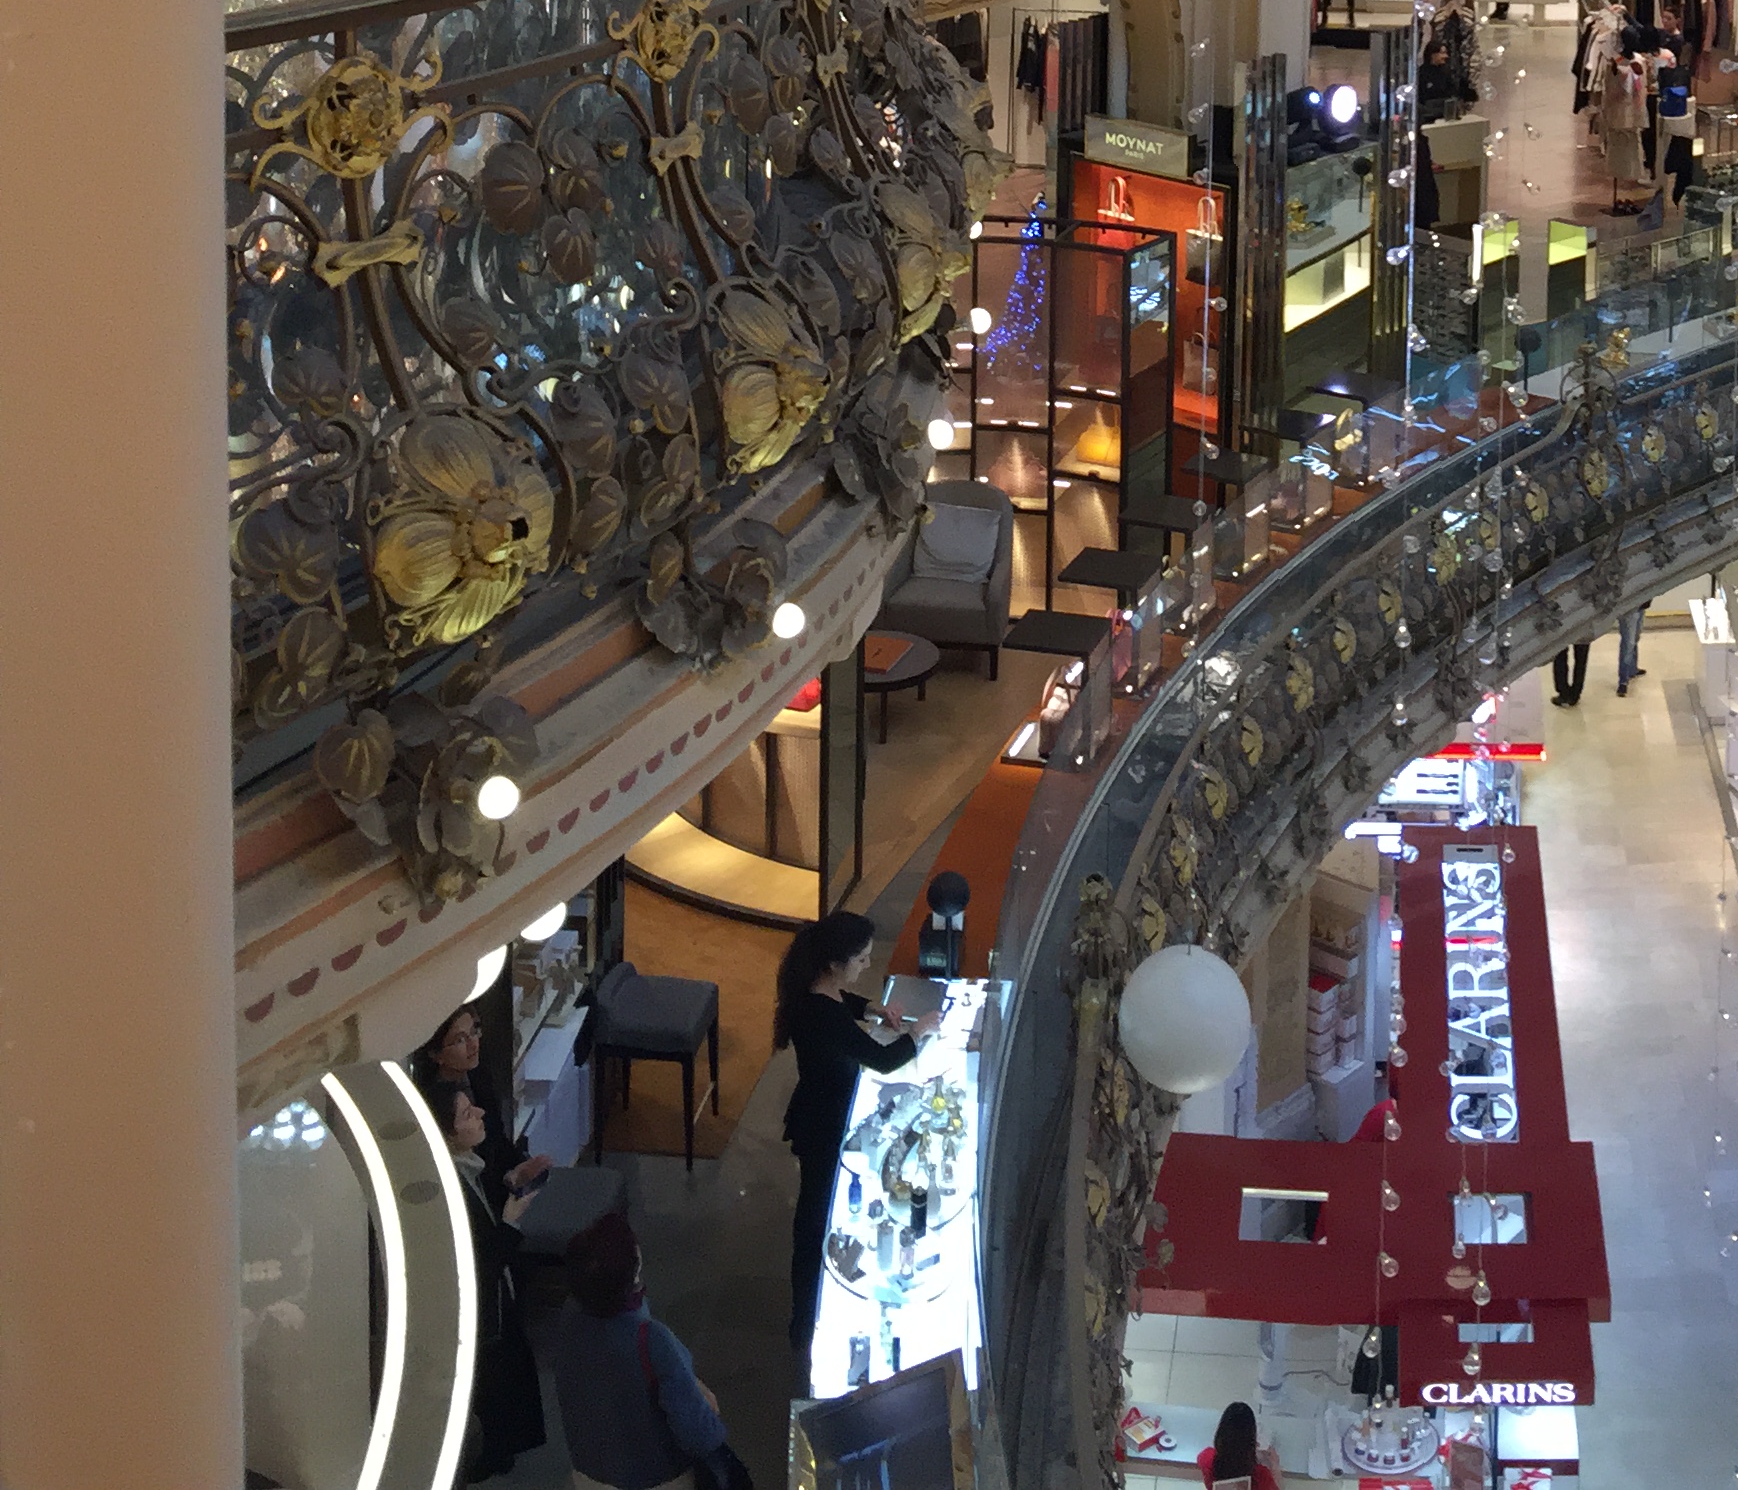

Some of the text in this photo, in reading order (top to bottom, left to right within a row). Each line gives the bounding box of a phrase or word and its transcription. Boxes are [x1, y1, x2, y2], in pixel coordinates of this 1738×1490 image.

[1105, 131, 1164, 156] MOYNAT
[1441, 861, 1518, 1141] CLARINS
[1421, 1382, 1577, 1404] CLARINS
